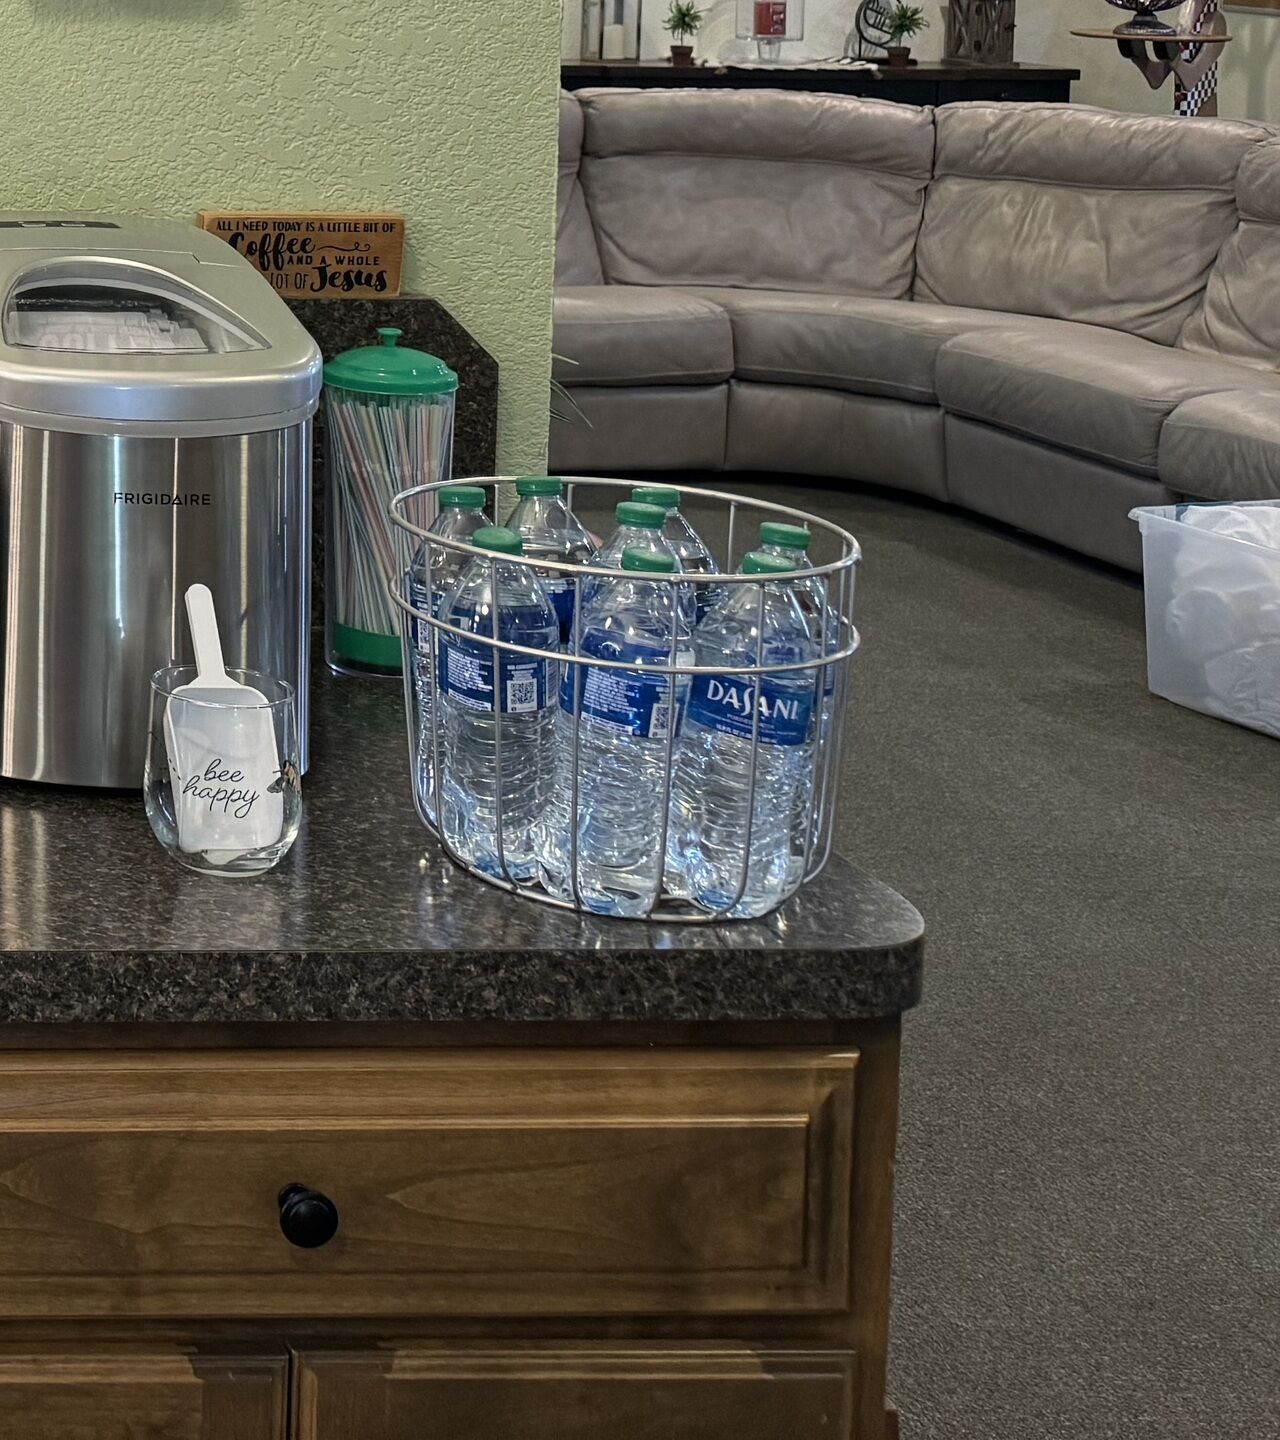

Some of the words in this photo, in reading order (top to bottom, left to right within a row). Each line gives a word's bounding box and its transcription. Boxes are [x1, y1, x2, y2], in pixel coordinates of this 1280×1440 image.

[216, 221, 233, 231] ALL
[236, 221, 240, 231] I
[242, 221, 268, 231] NEED
[272, 221, 303, 232] TODAY
[305, 222, 315, 232] IS
[317, 222, 325, 232] A
[327, 222, 360, 233] LITTLE
[363, 222, 379, 233] BIT
[382, 222, 396, 233] OF
[228, 232, 316, 271] Coffee
[287, 255, 313, 266] AND
[319, 255, 327, 265] A
[335, 256, 380, 266] WHOLE
[271, 272, 289, 290] LOT
[294, 272, 309, 290] OF
[310, 264, 388, 292] Jesus
[113, 492, 211, 506] FRIGIDAIRE
[706, 679, 799, 720] DASANI
[203, 758, 245, 783] bee
[182, 774, 261, 819] happy
